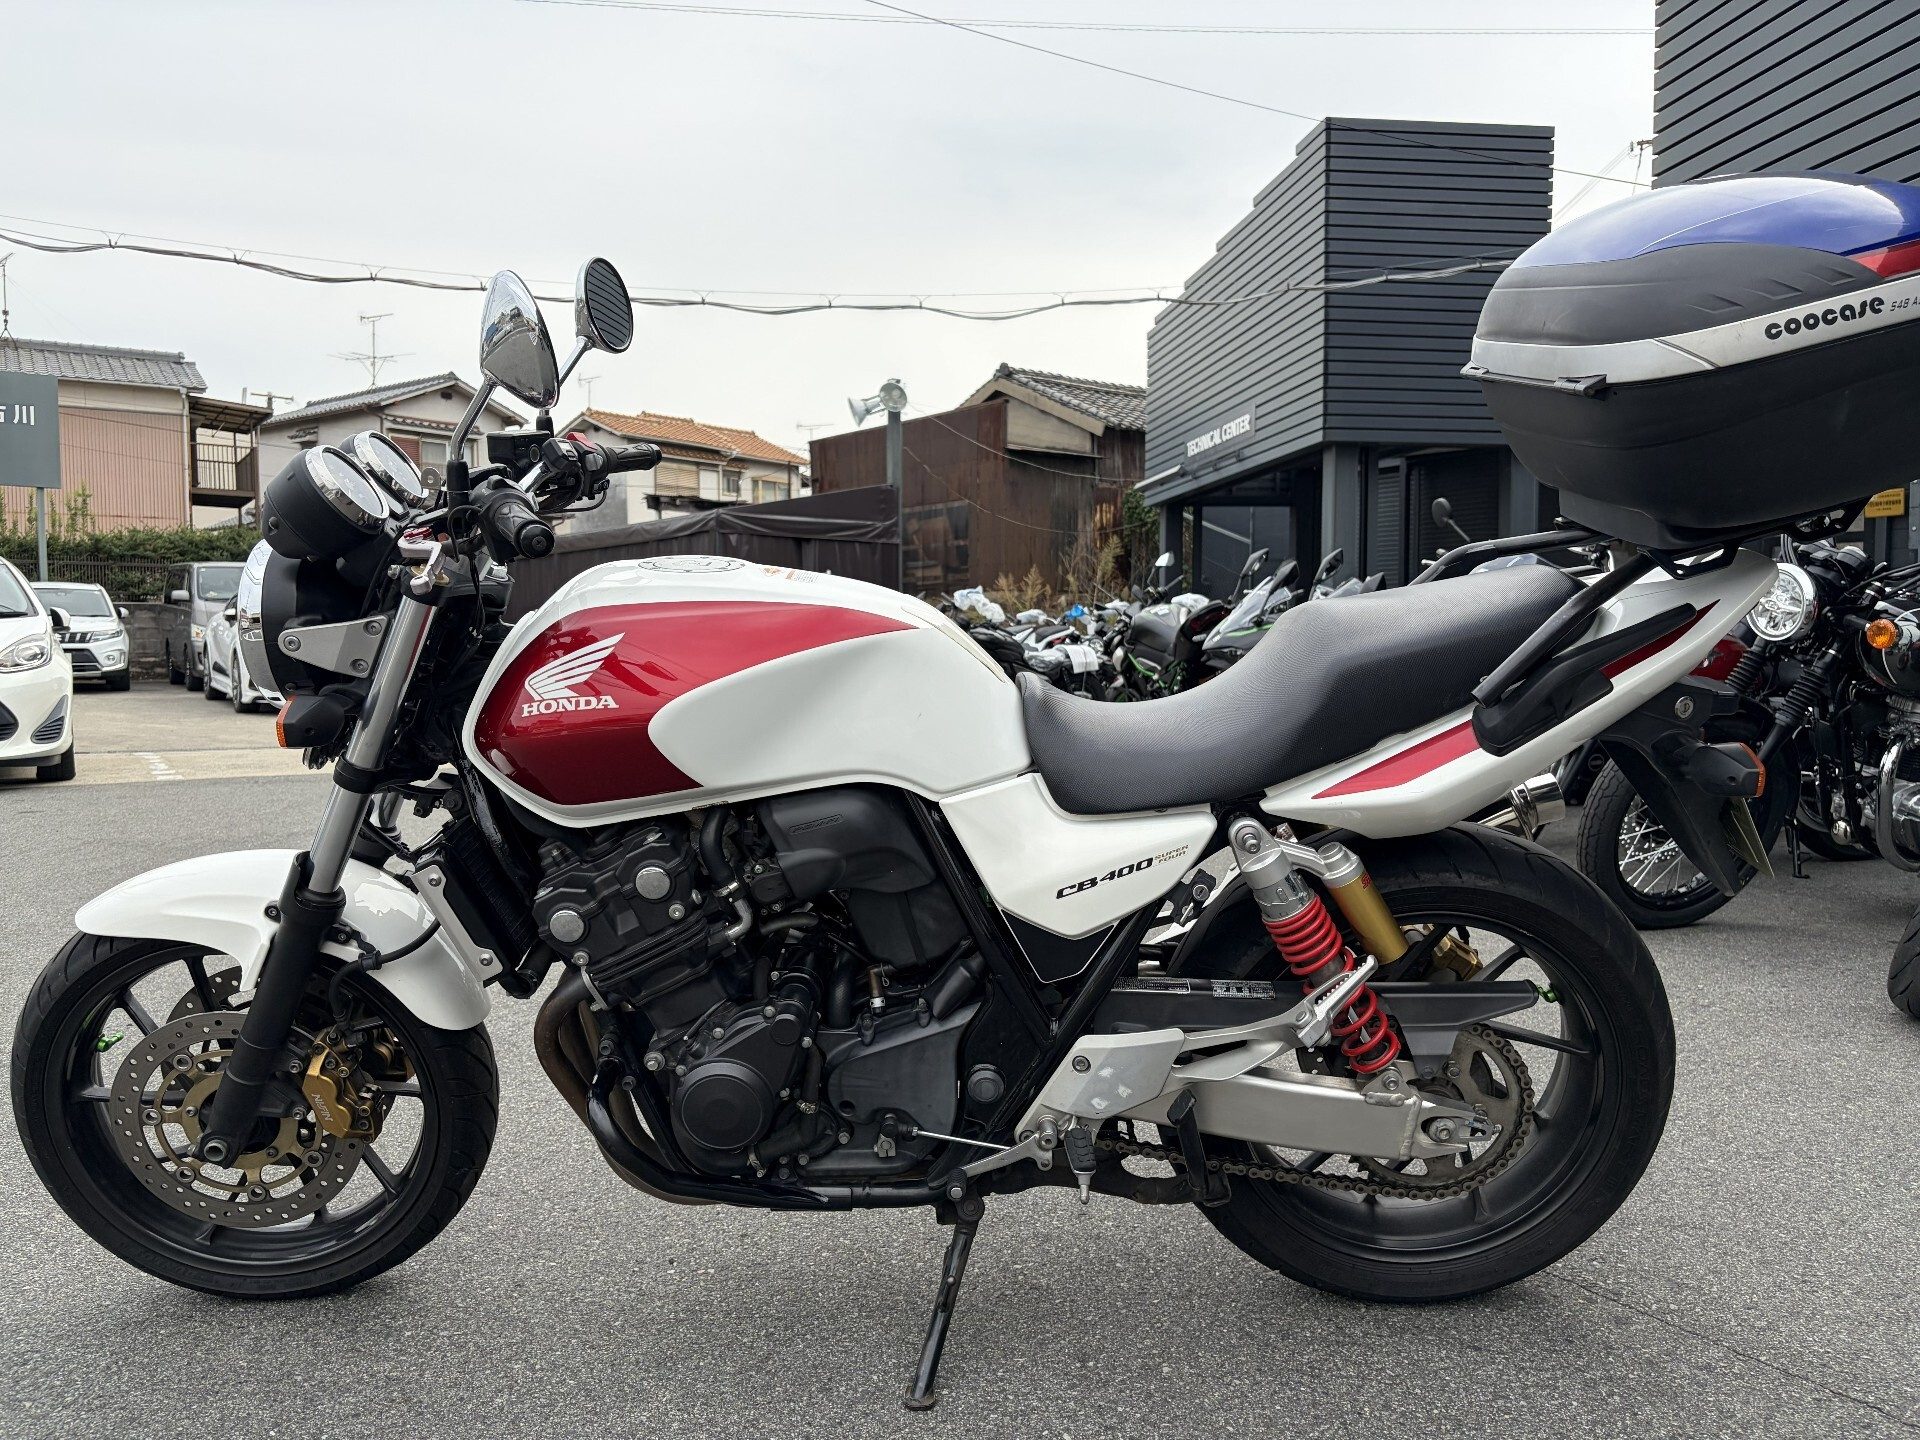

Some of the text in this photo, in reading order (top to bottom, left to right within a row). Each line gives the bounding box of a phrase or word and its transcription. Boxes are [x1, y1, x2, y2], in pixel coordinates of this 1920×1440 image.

[1764, 296, 1885, 340] coocase
[1187, 414, 1250, 457] TECHNICAL CENTER
[521, 695, 619, 717] HONDA
[1154, 844, 1189, 860] SUPER
[1158, 850, 1186, 863] FOUR
[1055, 857, 1154, 900] CB400
